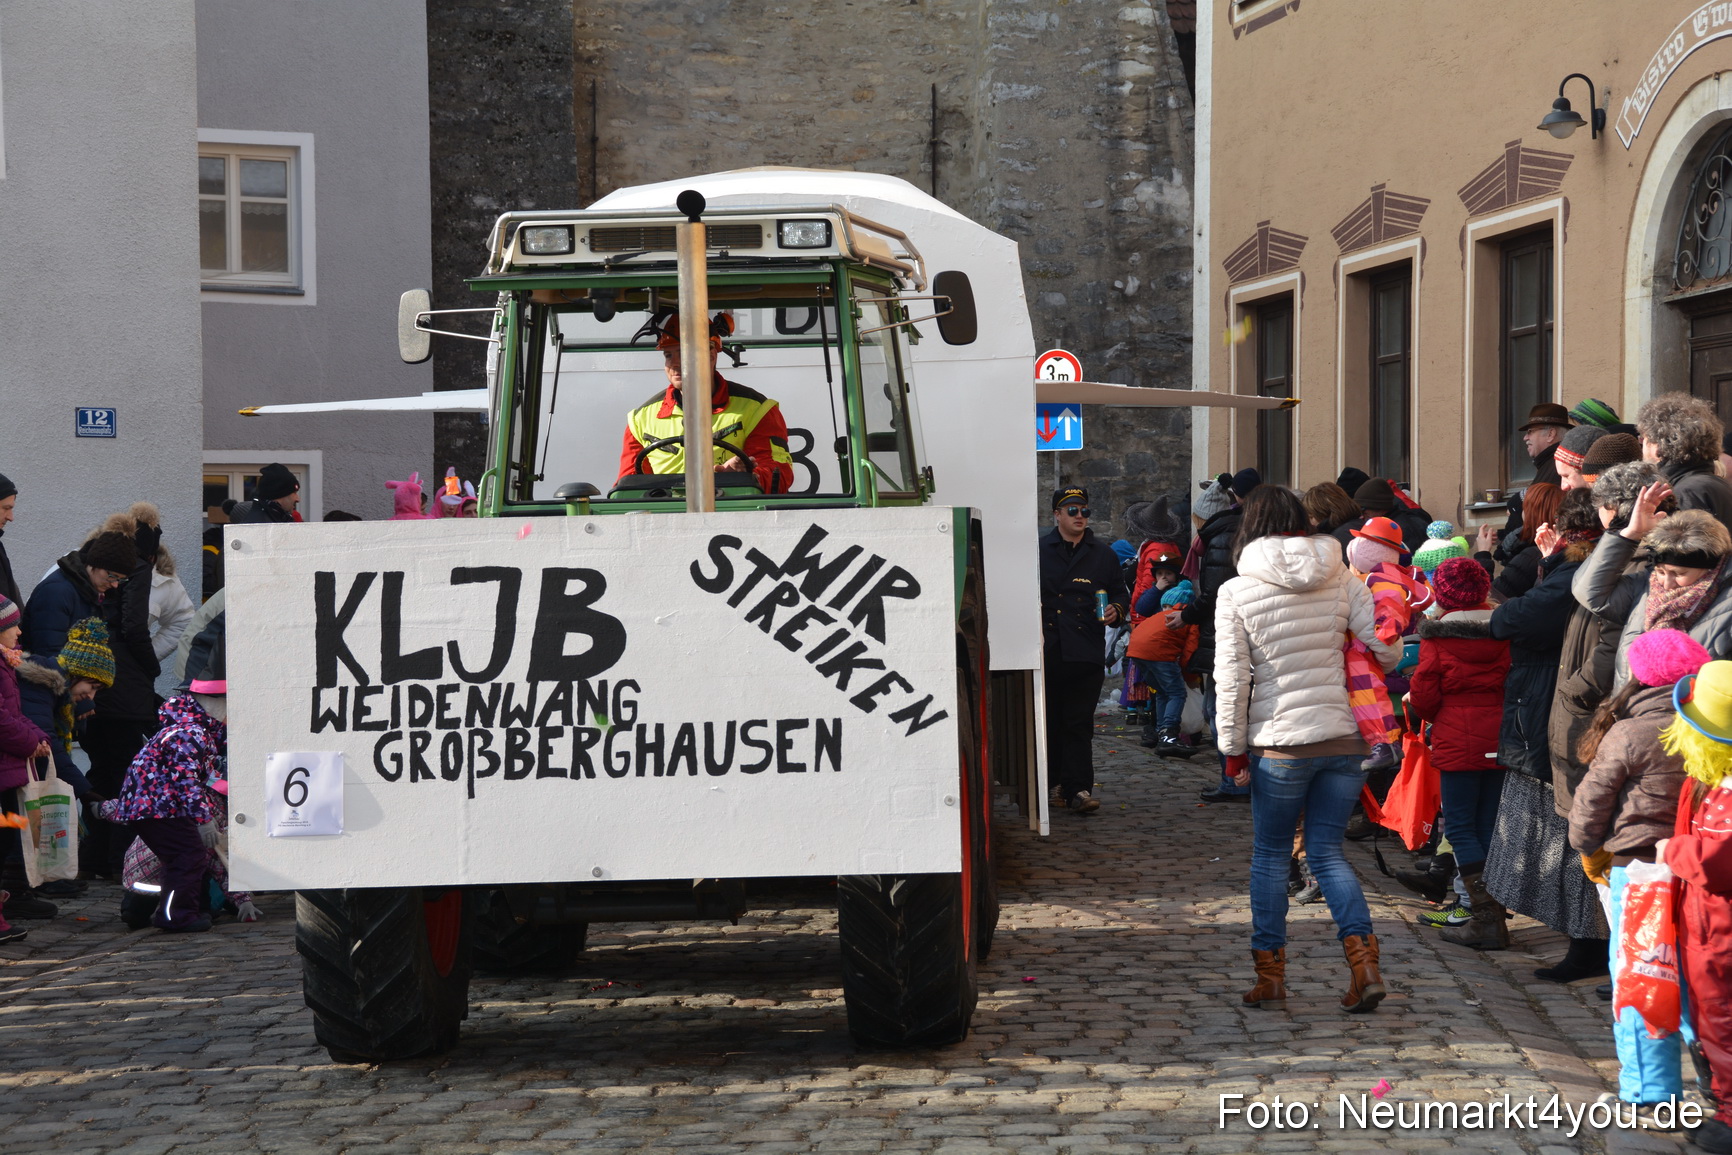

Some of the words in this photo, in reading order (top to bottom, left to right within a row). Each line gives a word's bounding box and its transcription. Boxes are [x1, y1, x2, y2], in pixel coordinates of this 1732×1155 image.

[1632, 32, 1685, 115] Bistro
[1046, 364, 1056, 381] 3
[85, 410, 108, 425] 12
[776, 523, 921, 645] WIR
[314, 565, 628, 689] KLJB
[690, 534, 949, 737] STREIKEN
[310, 679, 642, 733] WEIDENWANG
[283, 767, 310, 808] 6
